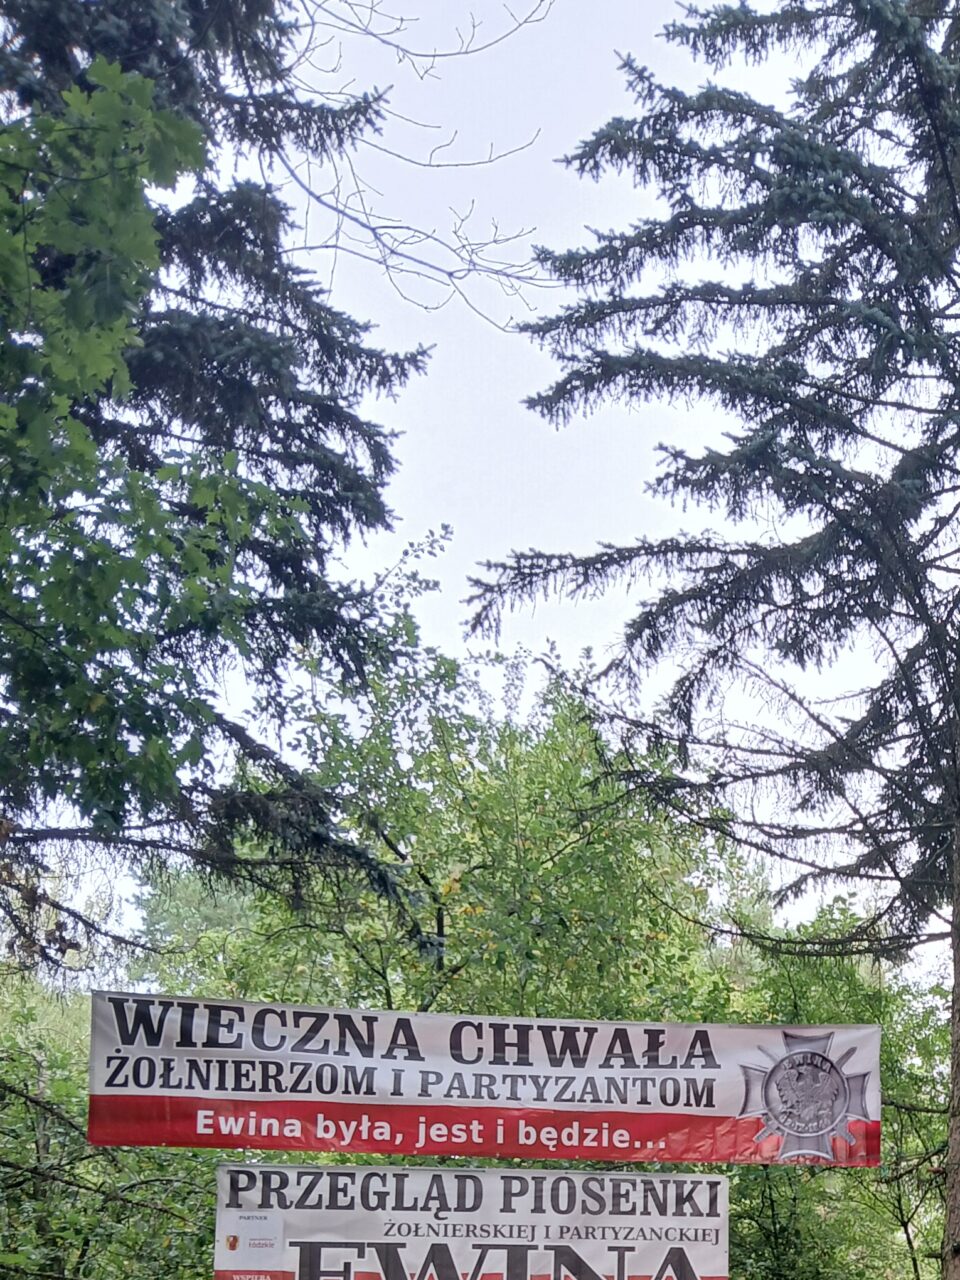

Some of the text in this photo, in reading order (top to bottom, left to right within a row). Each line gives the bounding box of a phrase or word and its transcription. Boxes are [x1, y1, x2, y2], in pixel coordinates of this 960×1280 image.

[107, 996, 721, 1071] WIECZNA CHWAŁA
[105, 1048, 716, 1108] ŻOŁNIERZOM I PARTYZANTOM
[196, 1109, 667, 1152] Ewina była, jest i będzie...
[225, 1169, 721, 1221] PRZEGLĄD PIOSENKI
[384, 1218, 720, 1246] ŻOŁNIERSKIEJ I PARTYZANCKIEJ
